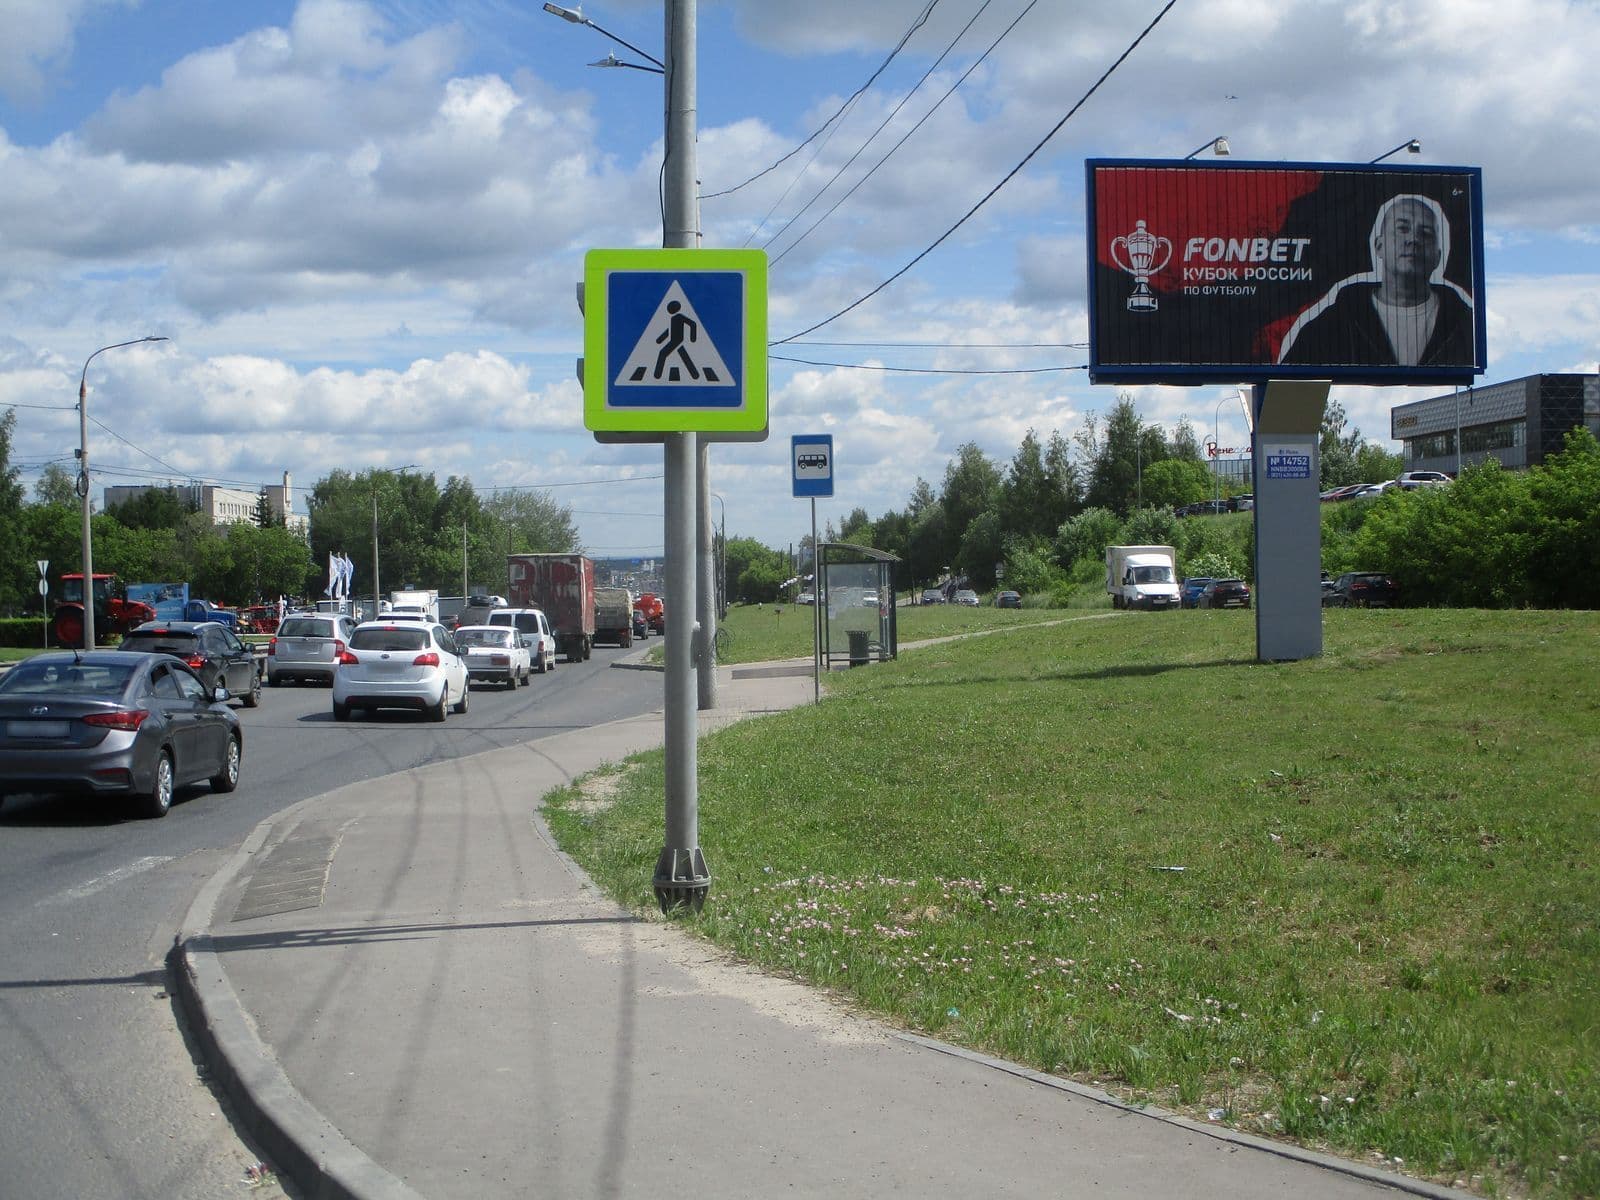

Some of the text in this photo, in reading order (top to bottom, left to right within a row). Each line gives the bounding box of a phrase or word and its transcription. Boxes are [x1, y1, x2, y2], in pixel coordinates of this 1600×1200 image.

[1183, 237, 1311, 262] FONBET
[1183, 267, 1312, 280] КУБОК РОССИИ
[1184, 285, 1257, 296] ПО ФУТБОЛУ
[1282, 456, 1308, 465] 14752
